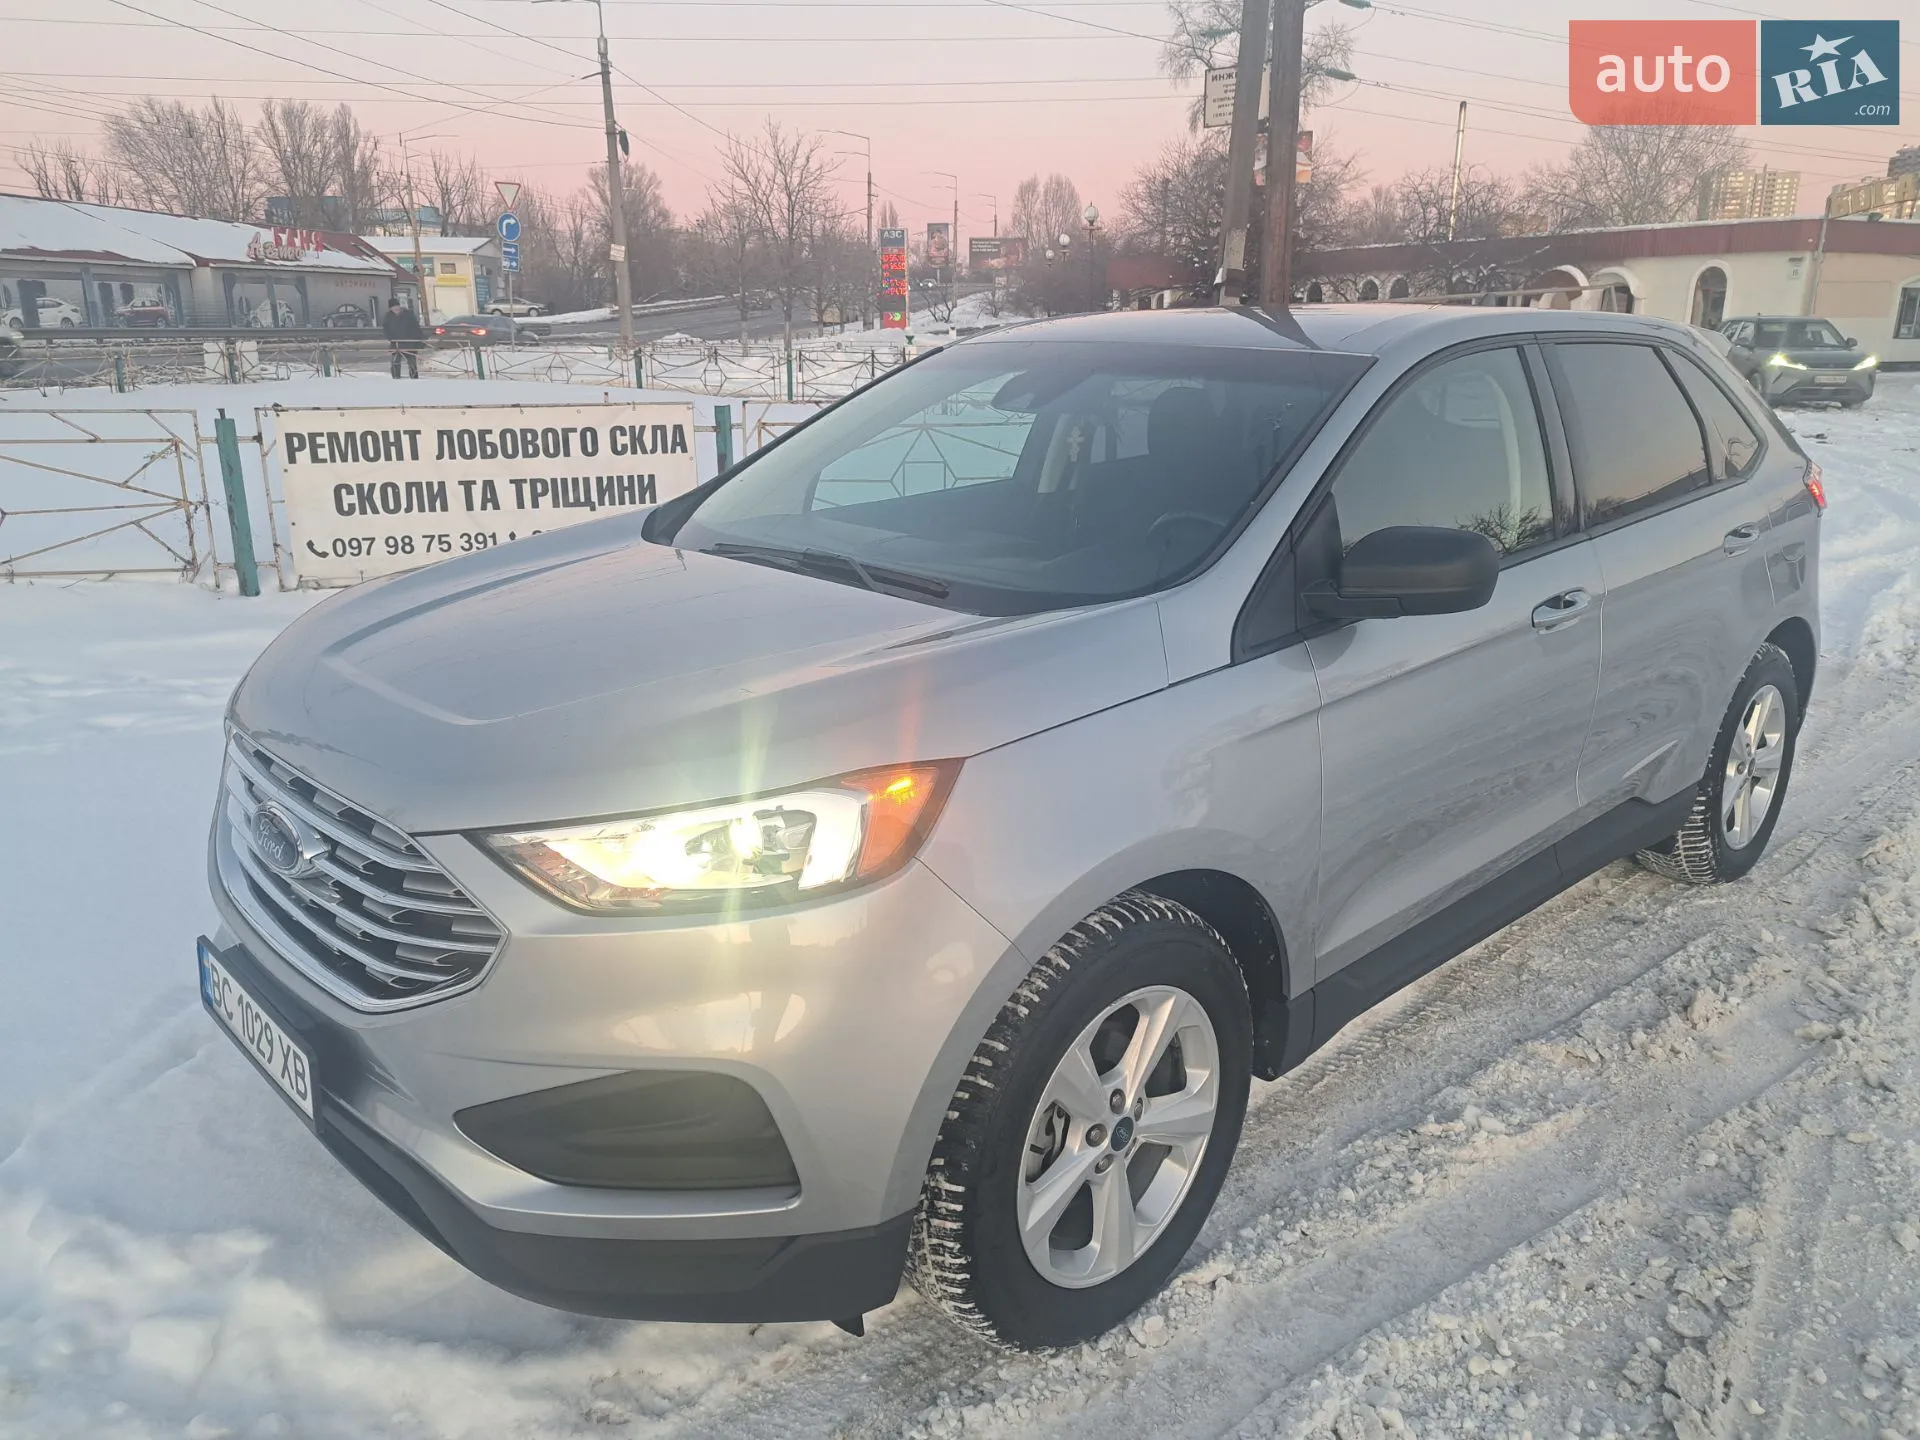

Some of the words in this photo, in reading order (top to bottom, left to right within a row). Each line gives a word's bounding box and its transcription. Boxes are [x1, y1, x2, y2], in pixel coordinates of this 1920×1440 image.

[883, 230, 903, 239] АЗС
[285, 430, 421, 464] РЕМОНТ
[436, 426, 599, 460] ЛОБОВОГО
[610, 424, 688, 456] СКЛА
[333, 481, 449, 516] СКОЛИ
[458, 480, 500, 511] ТА
[509, 474, 657, 511] ТРІЩИНИ
[332, 537, 376, 557] 097
[384, 535, 415, 555] 98
[422, 534, 452, 553] 75
[459, 532, 497, 551] 391
[258, 818, 286, 861] Ford
[237, 993, 274, 1065] 1029
